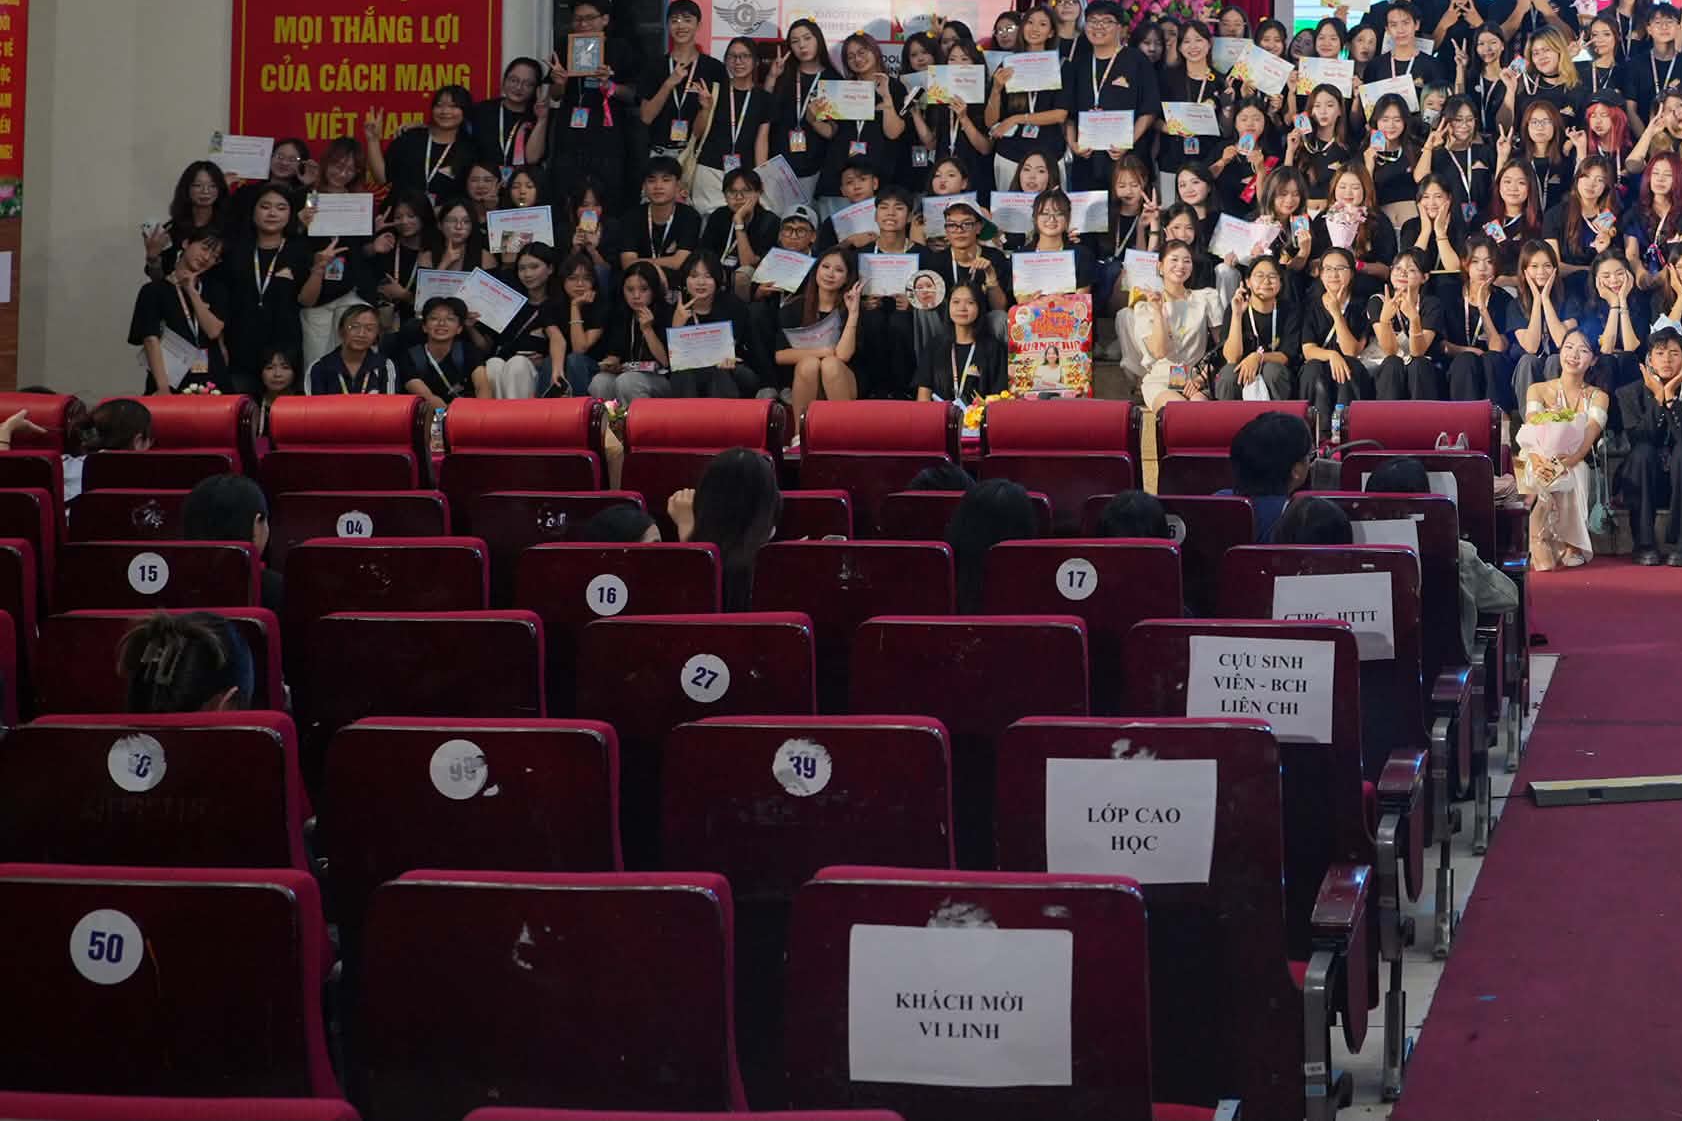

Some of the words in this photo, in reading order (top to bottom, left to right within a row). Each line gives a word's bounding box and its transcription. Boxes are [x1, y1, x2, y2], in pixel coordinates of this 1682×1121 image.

[274, 15, 323, 50] MỌI
[330, 5, 413, 44] THẮNG
[421, 13, 459, 50] LỢI
[260, 54, 312, 92] CỦA
[319, 58, 387, 92] CÁCH
[394, 64, 471, 98] MẠNG
[345, 520, 363, 535] 04
[138, 563, 159, 584] 15
[1067, 570, 1087, 588] 17
[597, 585, 618, 606] 16
[1219, 651, 1257, 670] CỰU
[1262, 655, 1304, 669] SINH
[690, 666, 719, 690] 27
[1213, 673, 1256, 690] VIÊN
[1271, 678, 1307, 693] BCH
[1220, 696, 1261, 714] LIÊN
[1266, 701, 1299, 715] CHI
[1087, 803, 1129, 823] LỚP
[1135, 807, 1182, 823] CAO
[1111, 835, 1159, 854] HỌC
[87, 930, 125, 965] 50
[896, 990, 974, 1011] KHÁCH
[980, 991, 1025, 1012] MỜI
[919, 1021, 940, 1038] VI
[948, 1022, 1000, 1039] LINH
